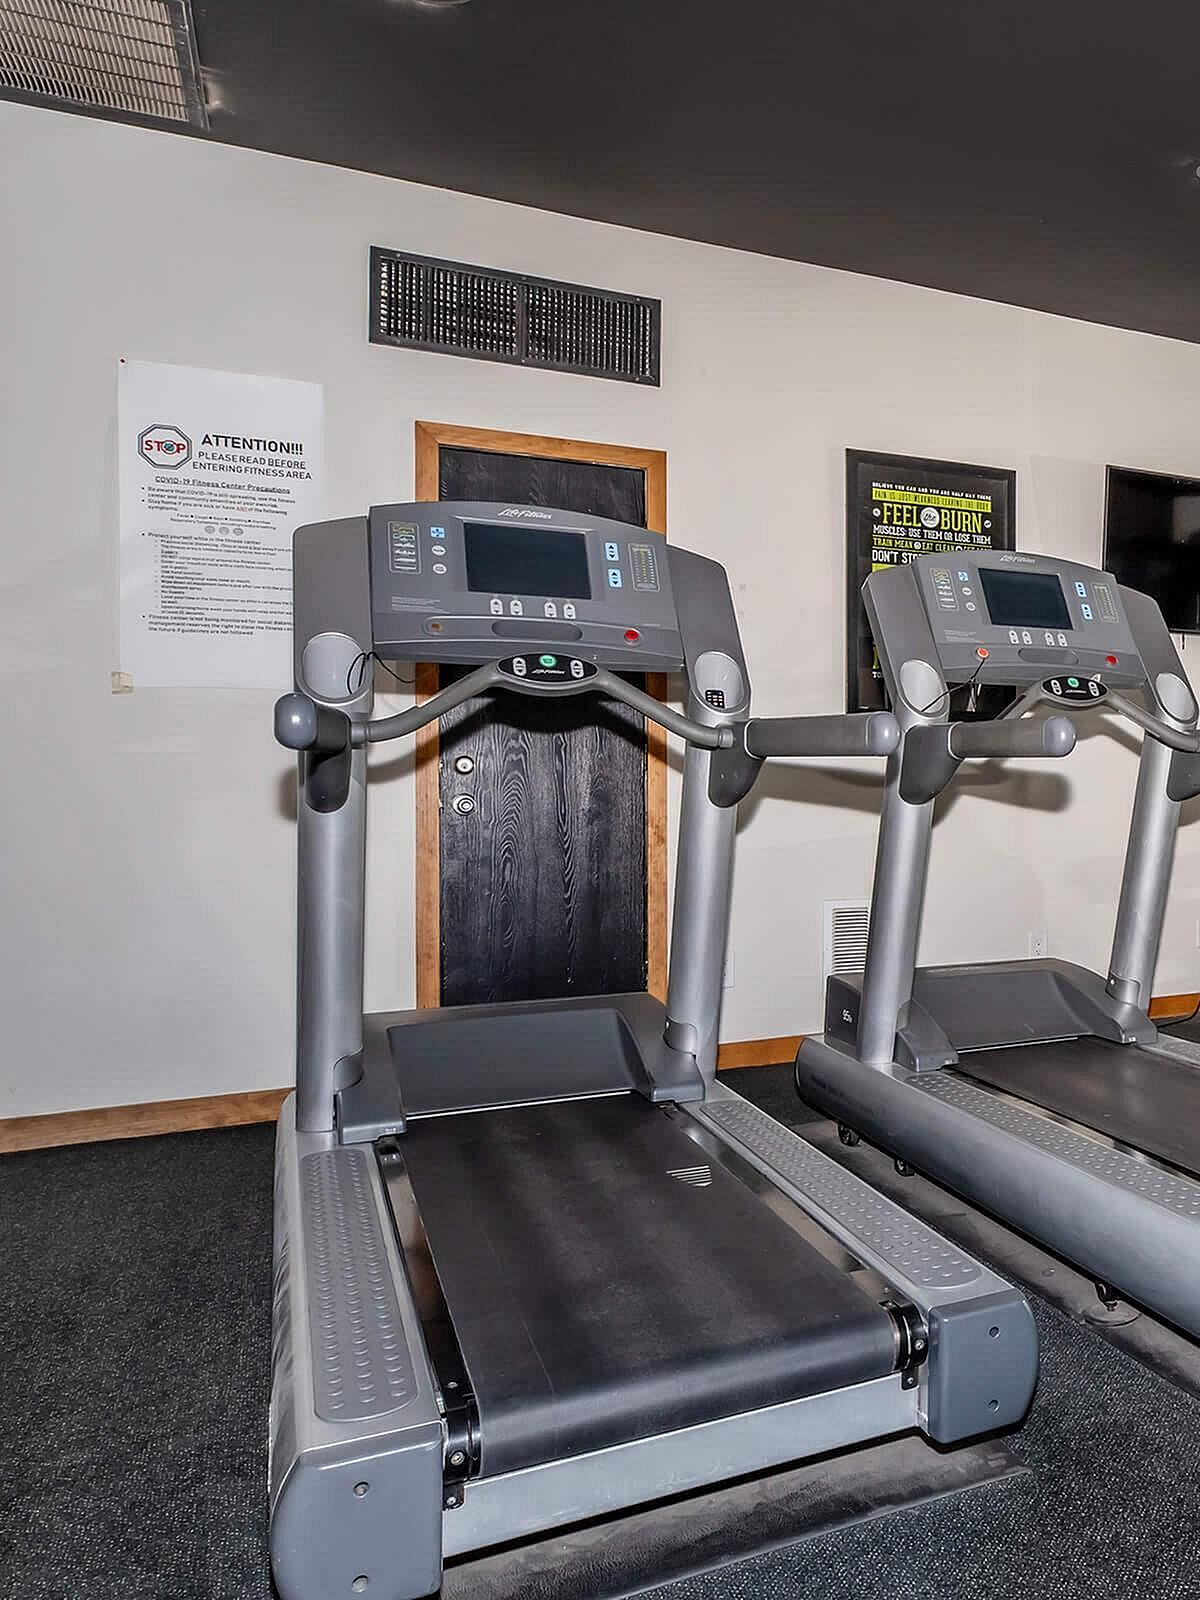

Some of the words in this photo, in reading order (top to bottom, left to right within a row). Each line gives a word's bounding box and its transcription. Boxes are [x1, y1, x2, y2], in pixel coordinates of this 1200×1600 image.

[145, 440, 186, 455] STOP
[201, 434, 304, 455] ATTENTION!!!
[198, 451, 238, 463] PLEASE
[239, 455, 265, 465] READ
[268, 458, 306, 469] BEFORE
[193, 462, 243, 473] ENTERING
[245, 467, 284, 477] FITNESS
[286, 471, 312, 480] AREA
[155, 476, 190, 485] COVID-19
[192, 479, 220, 488] Fitness
[248, 484, 290, 494] Precautions
[882, 503, 921, 527] FEEL
[924, 512, 936, 522] the
[941, 509, 982, 534] BURN
[873, 537, 892, 546] TRAIN
[894, 540, 913, 548] MEAN
[922, 542, 933, 550] EAT
[908, 528, 921, 538] USE
[923, 529, 942, 540] THEM
[944, 532, 953, 541] OR
[955, 533, 971, 542] LOSE
[972, 534, 991, 544] THEM
[872, 550, 898, 563] DON'T
